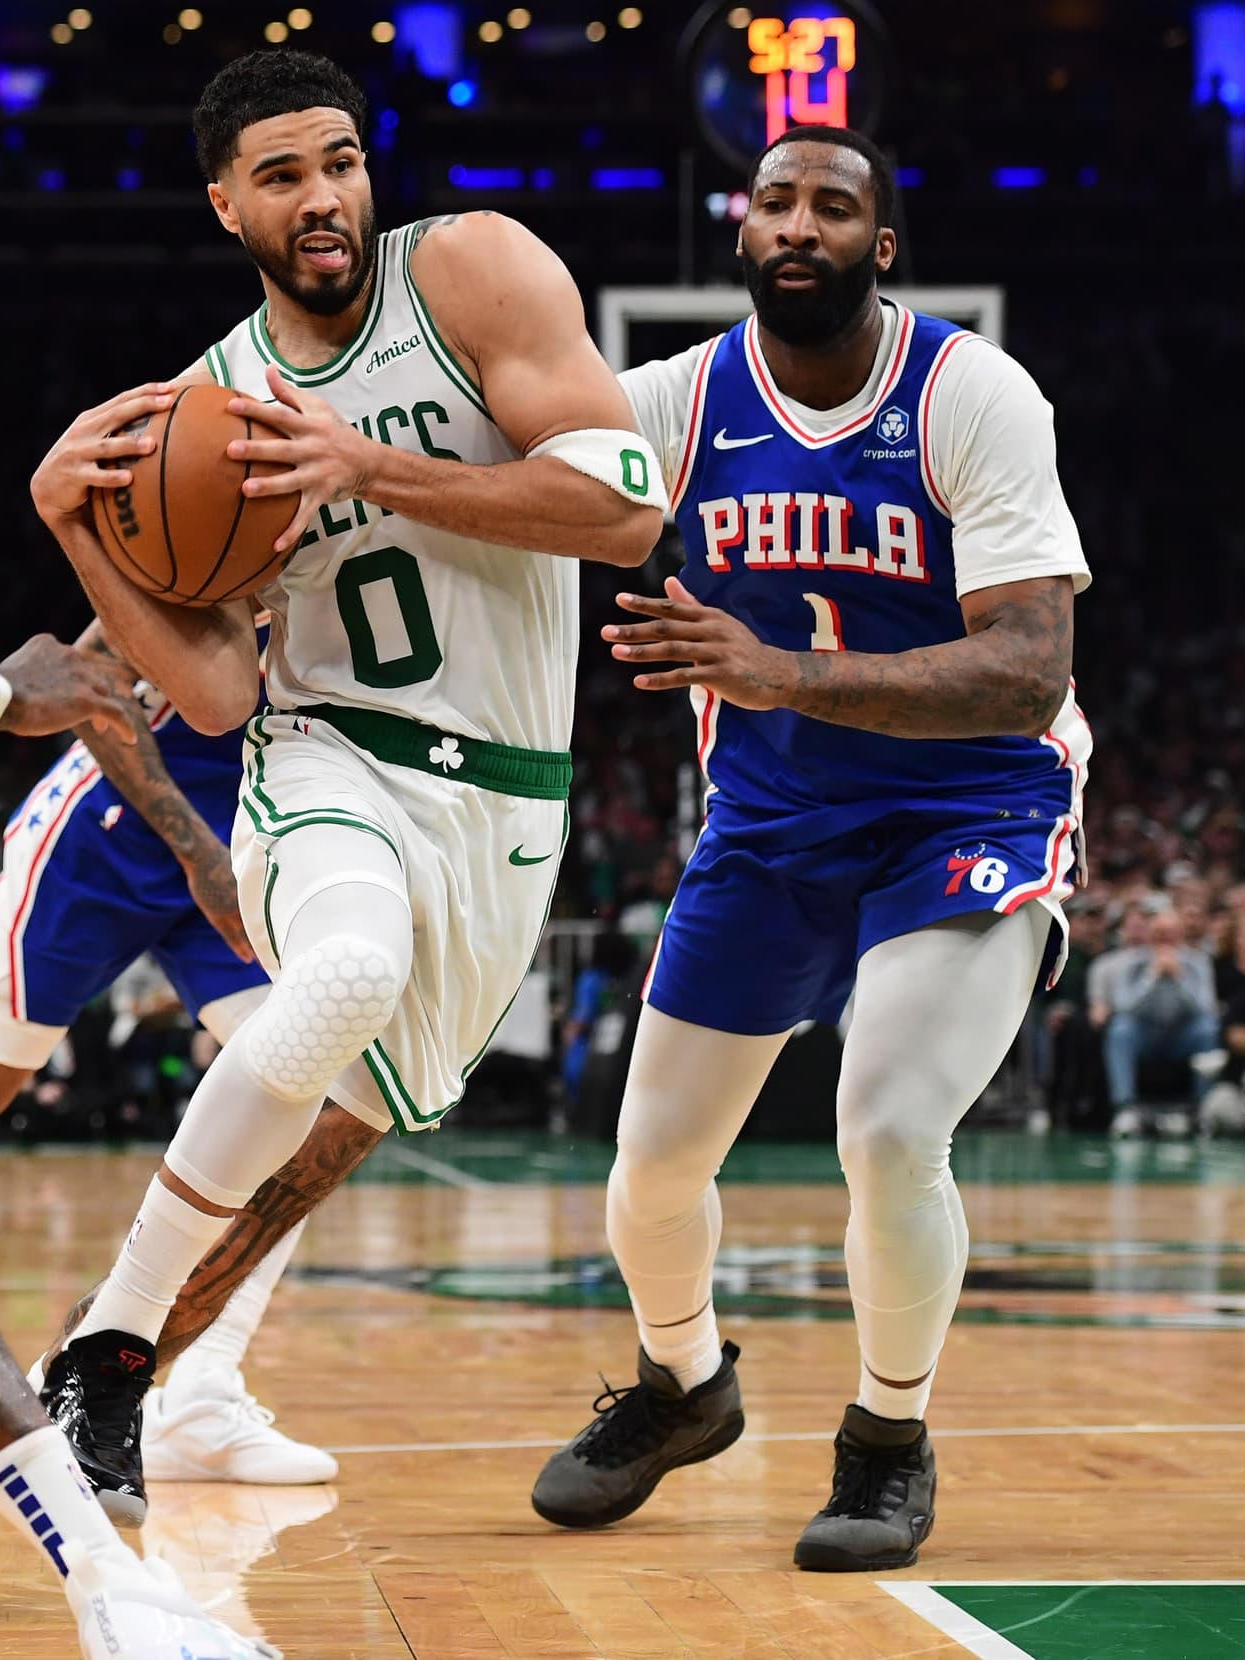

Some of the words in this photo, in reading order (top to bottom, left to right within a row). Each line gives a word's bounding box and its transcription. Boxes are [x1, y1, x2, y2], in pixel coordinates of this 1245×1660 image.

[366, 334, 422, 374] Amica
[619, 448, 649, 497] 0
[862, 449, 917, 461] crypto.com
[698, 492, 931, 585] PHILA
[334, 545, 443, 689] 0
[802, 592, 846, 652] 1
[944, 856, 1009, 897] 76
